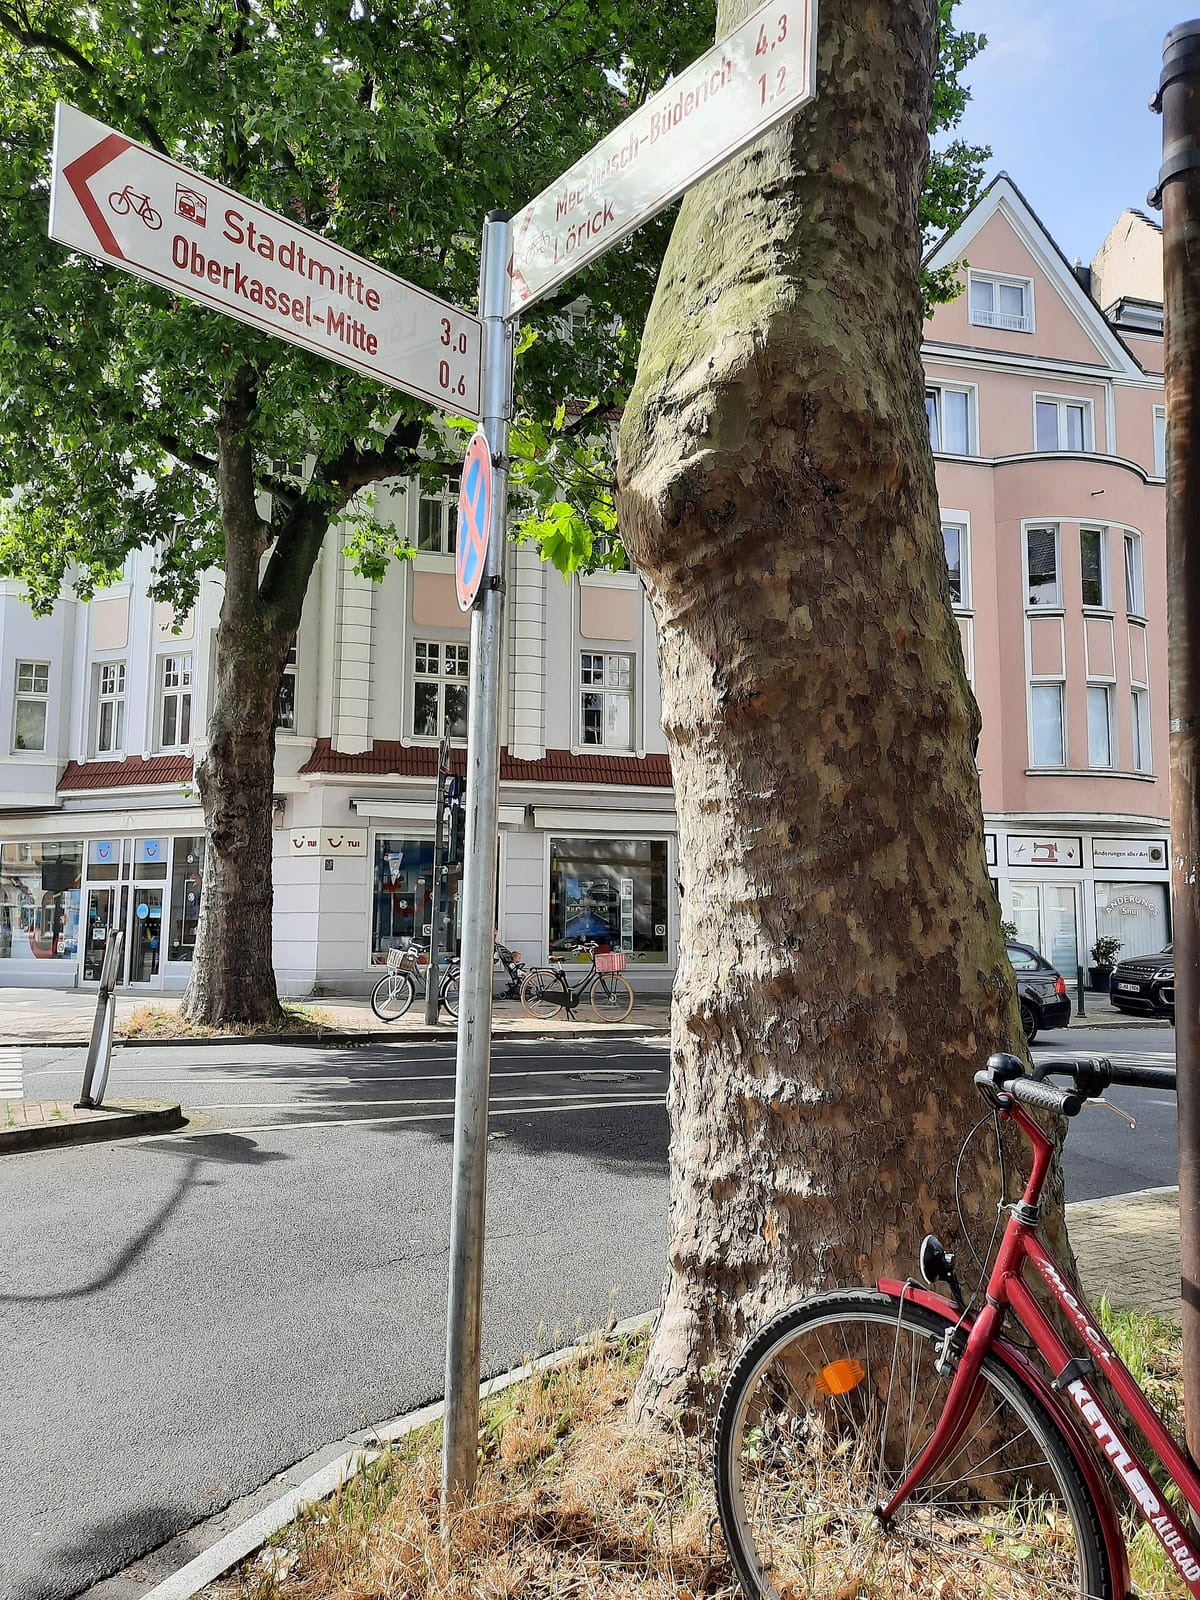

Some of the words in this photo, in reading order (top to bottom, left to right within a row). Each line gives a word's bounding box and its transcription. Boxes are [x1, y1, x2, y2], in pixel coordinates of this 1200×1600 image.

[223, 209, 380, 312] Stadtmitte
[553, 198, 615, 264] Lörick
[172, 234, 379, 356] Oberkassel-Mitte
[347, 840, 360, 848] TUI
[1121, 907, 1142, 917] Shop
[1067, 1379, 1160, 1519] KETTLER
[1151, 1515, 1200, 1582] ALU-RAD
